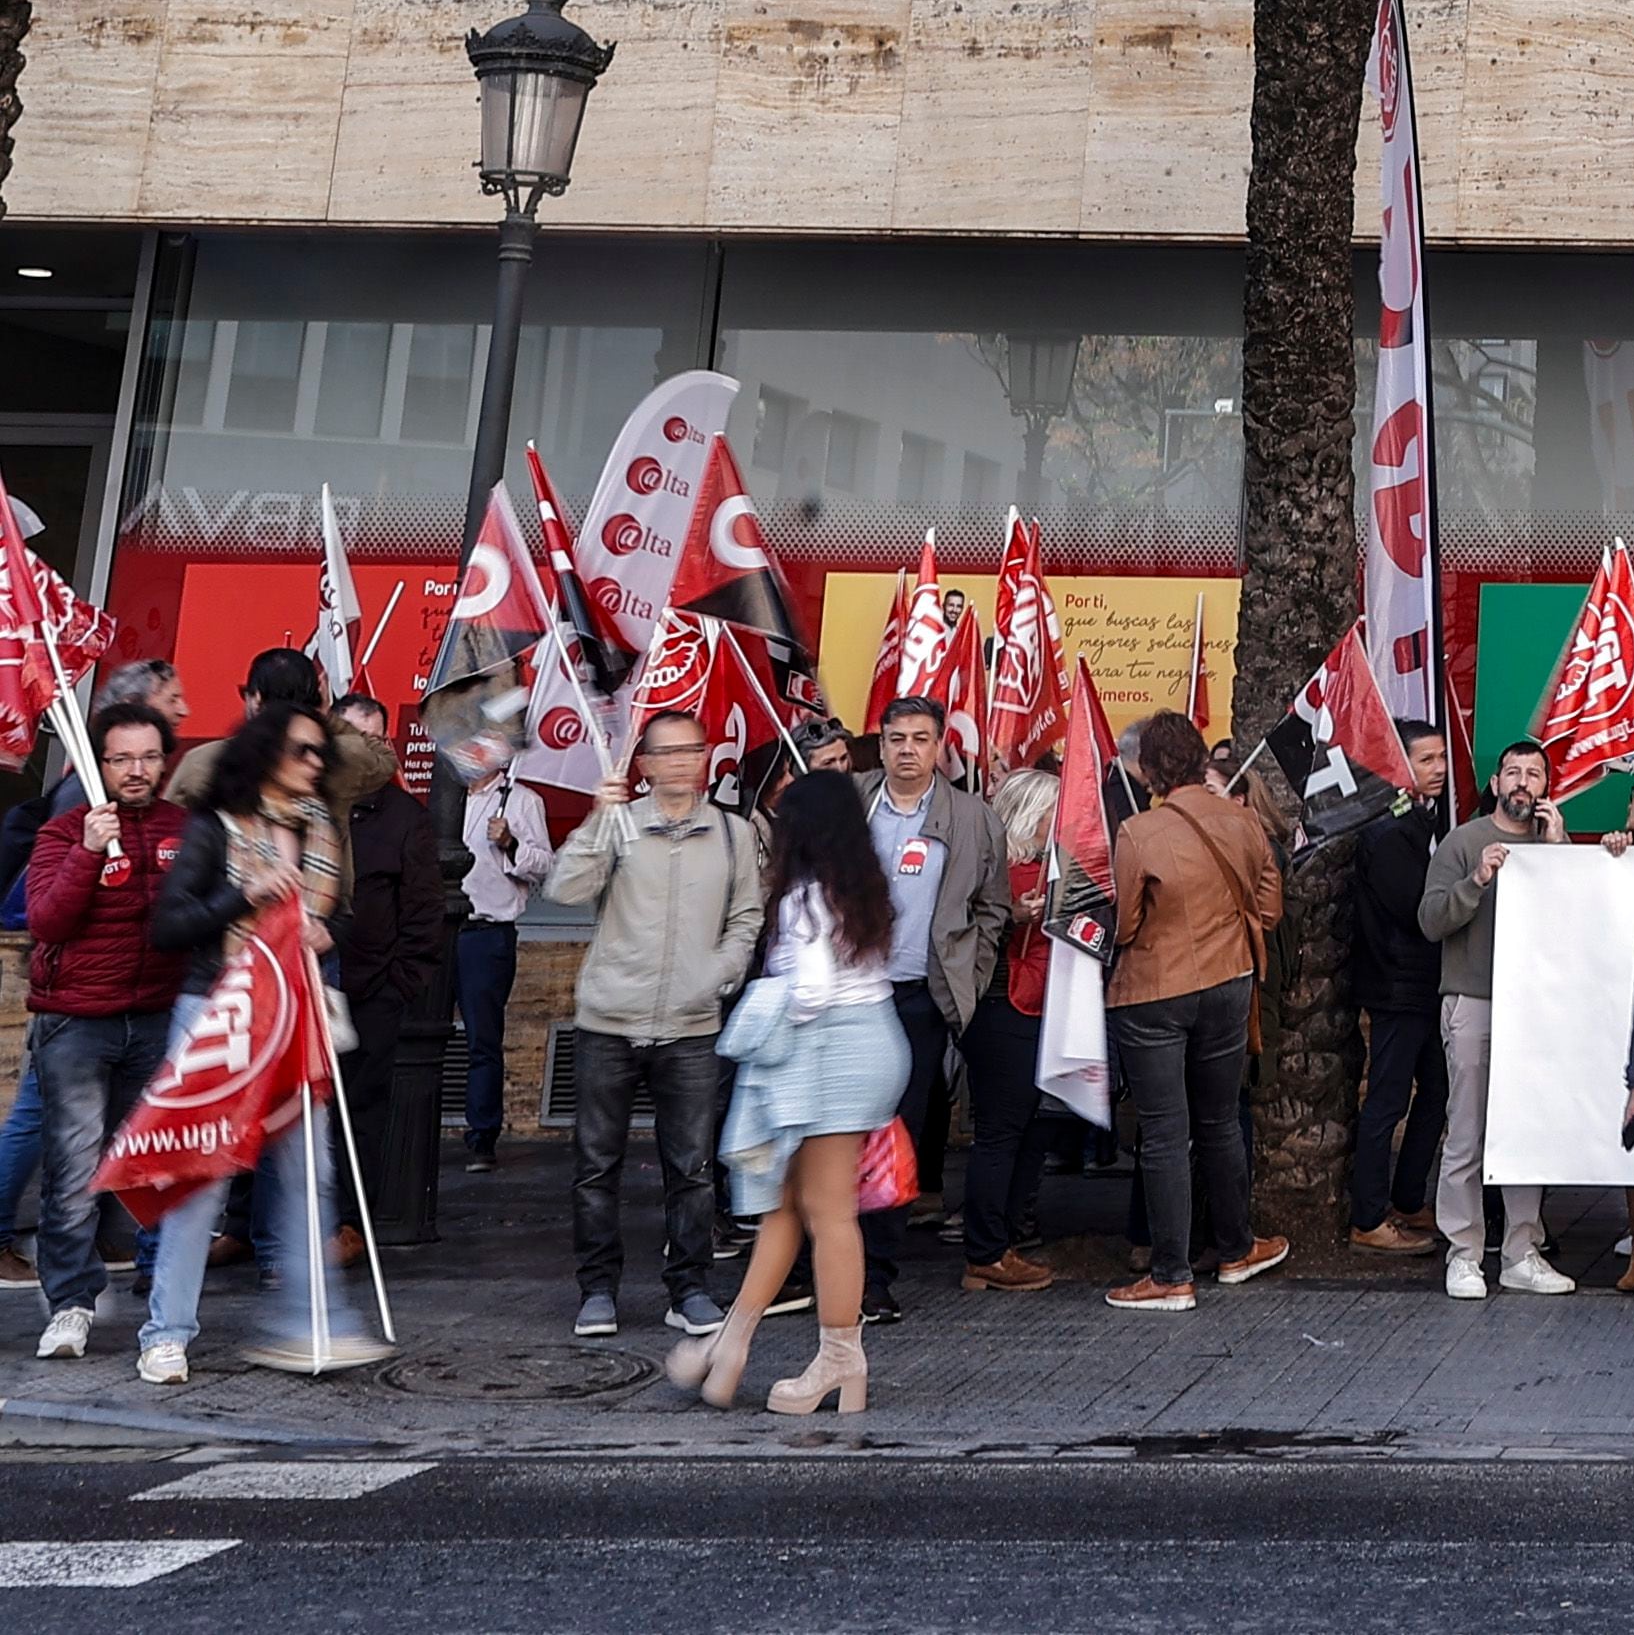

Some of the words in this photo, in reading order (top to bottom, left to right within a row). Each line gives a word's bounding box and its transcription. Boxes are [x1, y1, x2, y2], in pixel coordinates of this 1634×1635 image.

[424, 580, 451, 596] Por
[1065, 594, 1090, 608] Por
[1093, 594, 1108, 610] ti,
[1064, 616, 1097, 636] que
[1105, 611, 1160, 631] buscas
[1165, 613, 1195, 633] las
[1078, 634, 1140, 665] mejores
[1091, 667, 1123, 678] ara
[1126, 659, 1155, 679] tu
[413, 674, 429, 691] lo
[1098, 688, 1154, 703] imeros.
[158, 849, 180, 860] UG
[102, 861, 119, 875] GT
